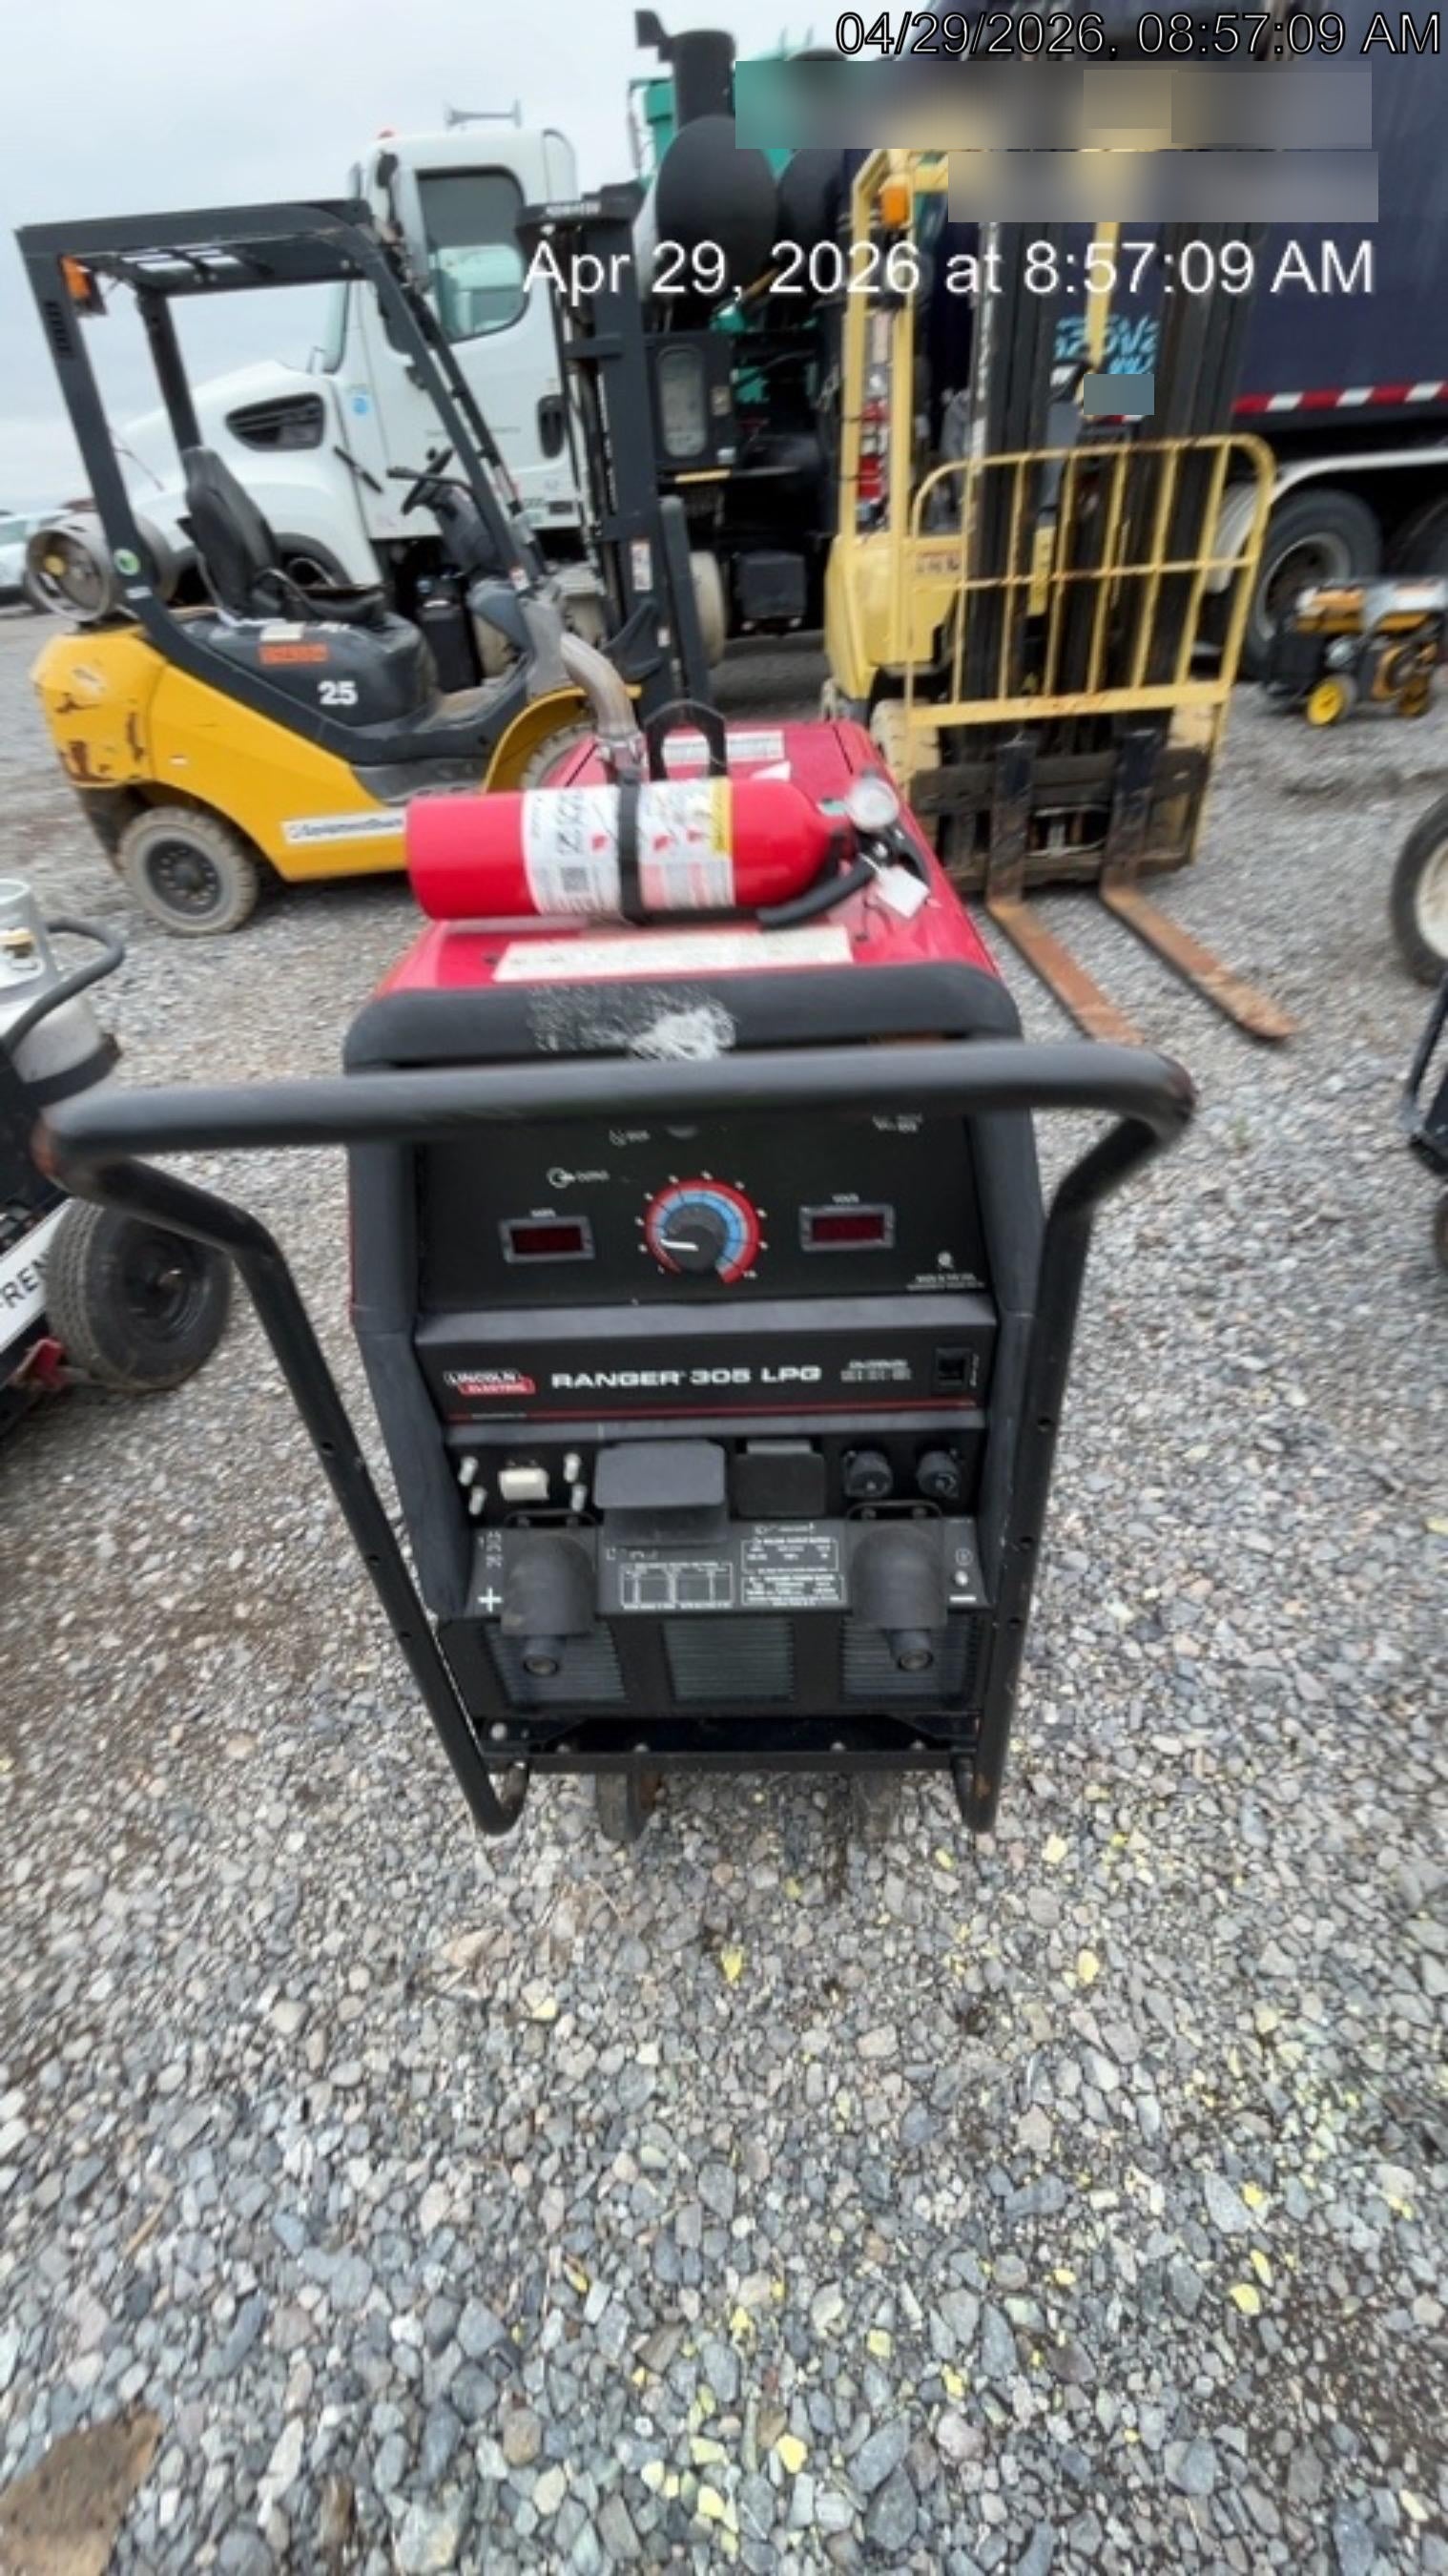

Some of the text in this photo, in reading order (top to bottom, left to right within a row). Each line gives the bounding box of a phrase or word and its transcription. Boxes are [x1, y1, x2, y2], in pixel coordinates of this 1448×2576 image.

[317, 679, 359, 705] 25
[0, 1254, 48, 1308] REN
[551, 1370, 681, 1388] RANGER
[690, 1367, 751, 1385] 305
[760, 1364, 822, 1382] LPG
